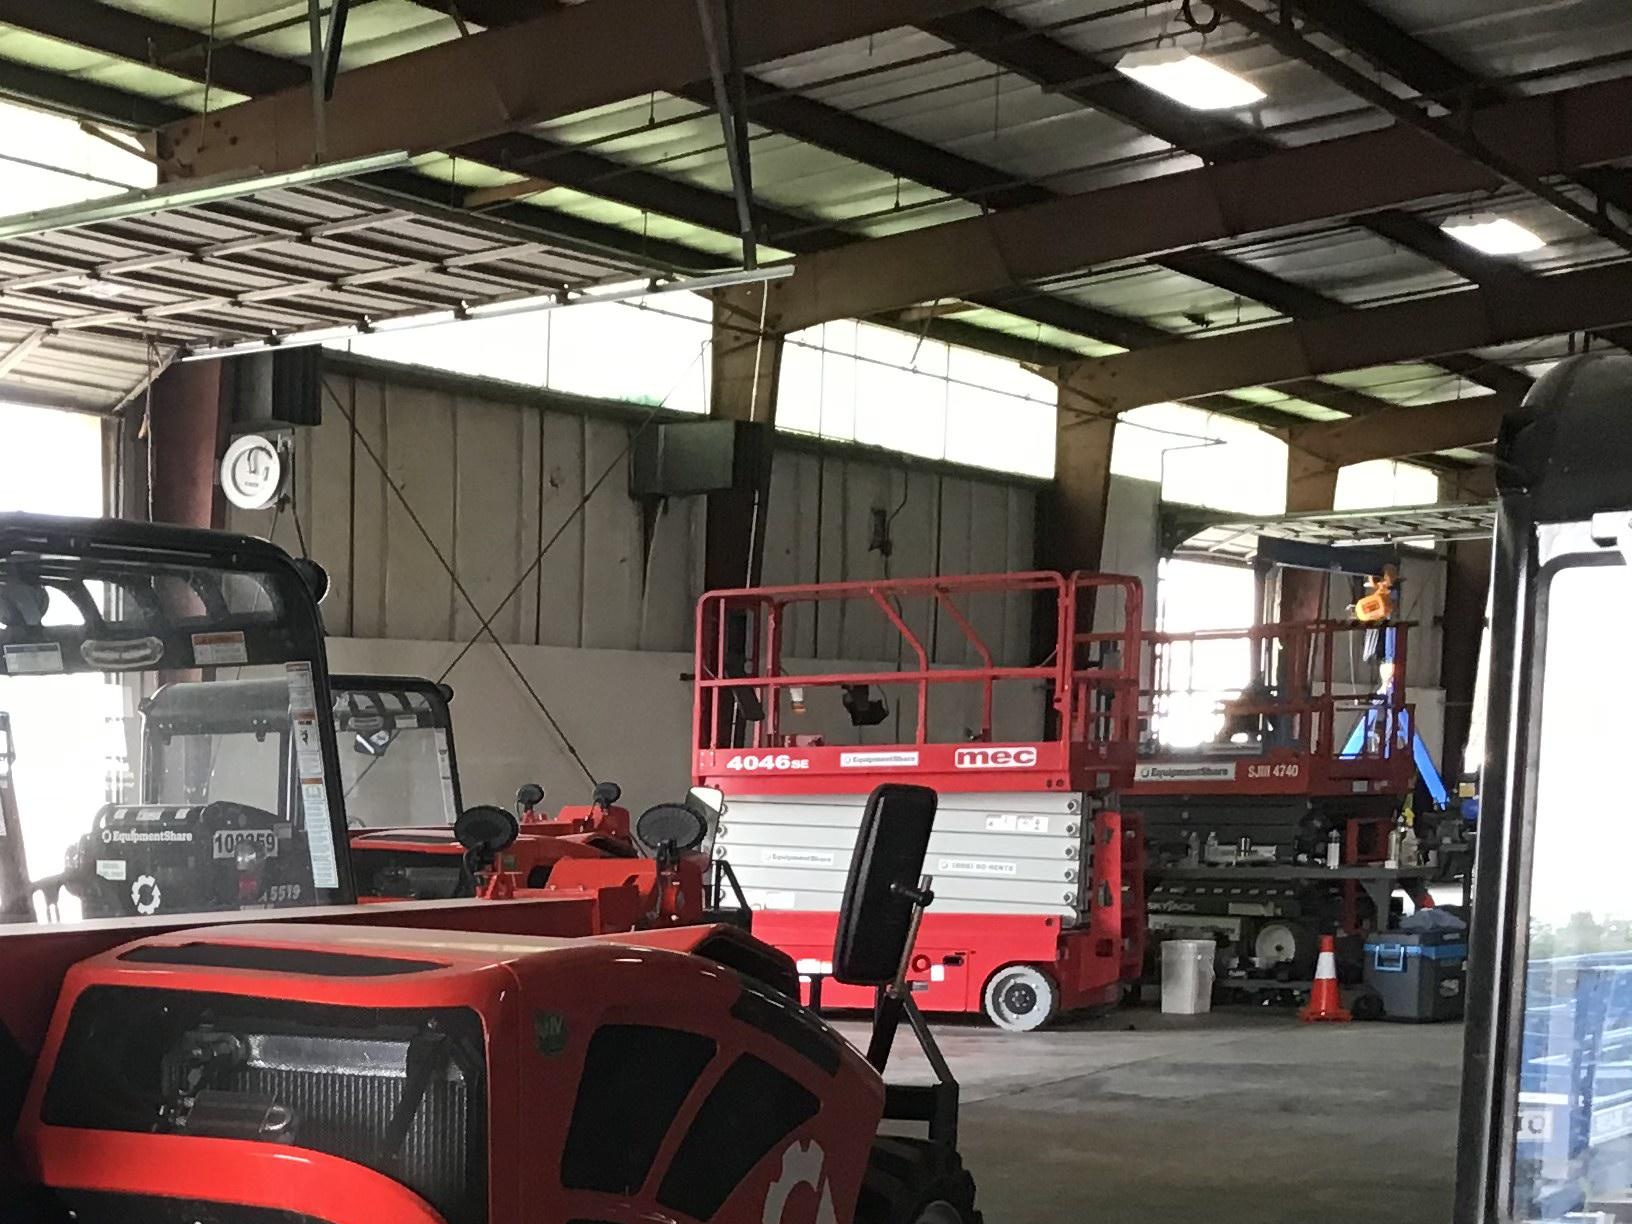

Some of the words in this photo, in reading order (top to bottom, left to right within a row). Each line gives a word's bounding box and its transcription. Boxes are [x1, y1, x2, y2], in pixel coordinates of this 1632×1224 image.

[956, 749, 1035, 766] mec
[1151, 766, 1228, 778] EquipmentShare
[1273, 764, 1299, 778] 4740
[112, 828, 193, 843] EquipmentShare
